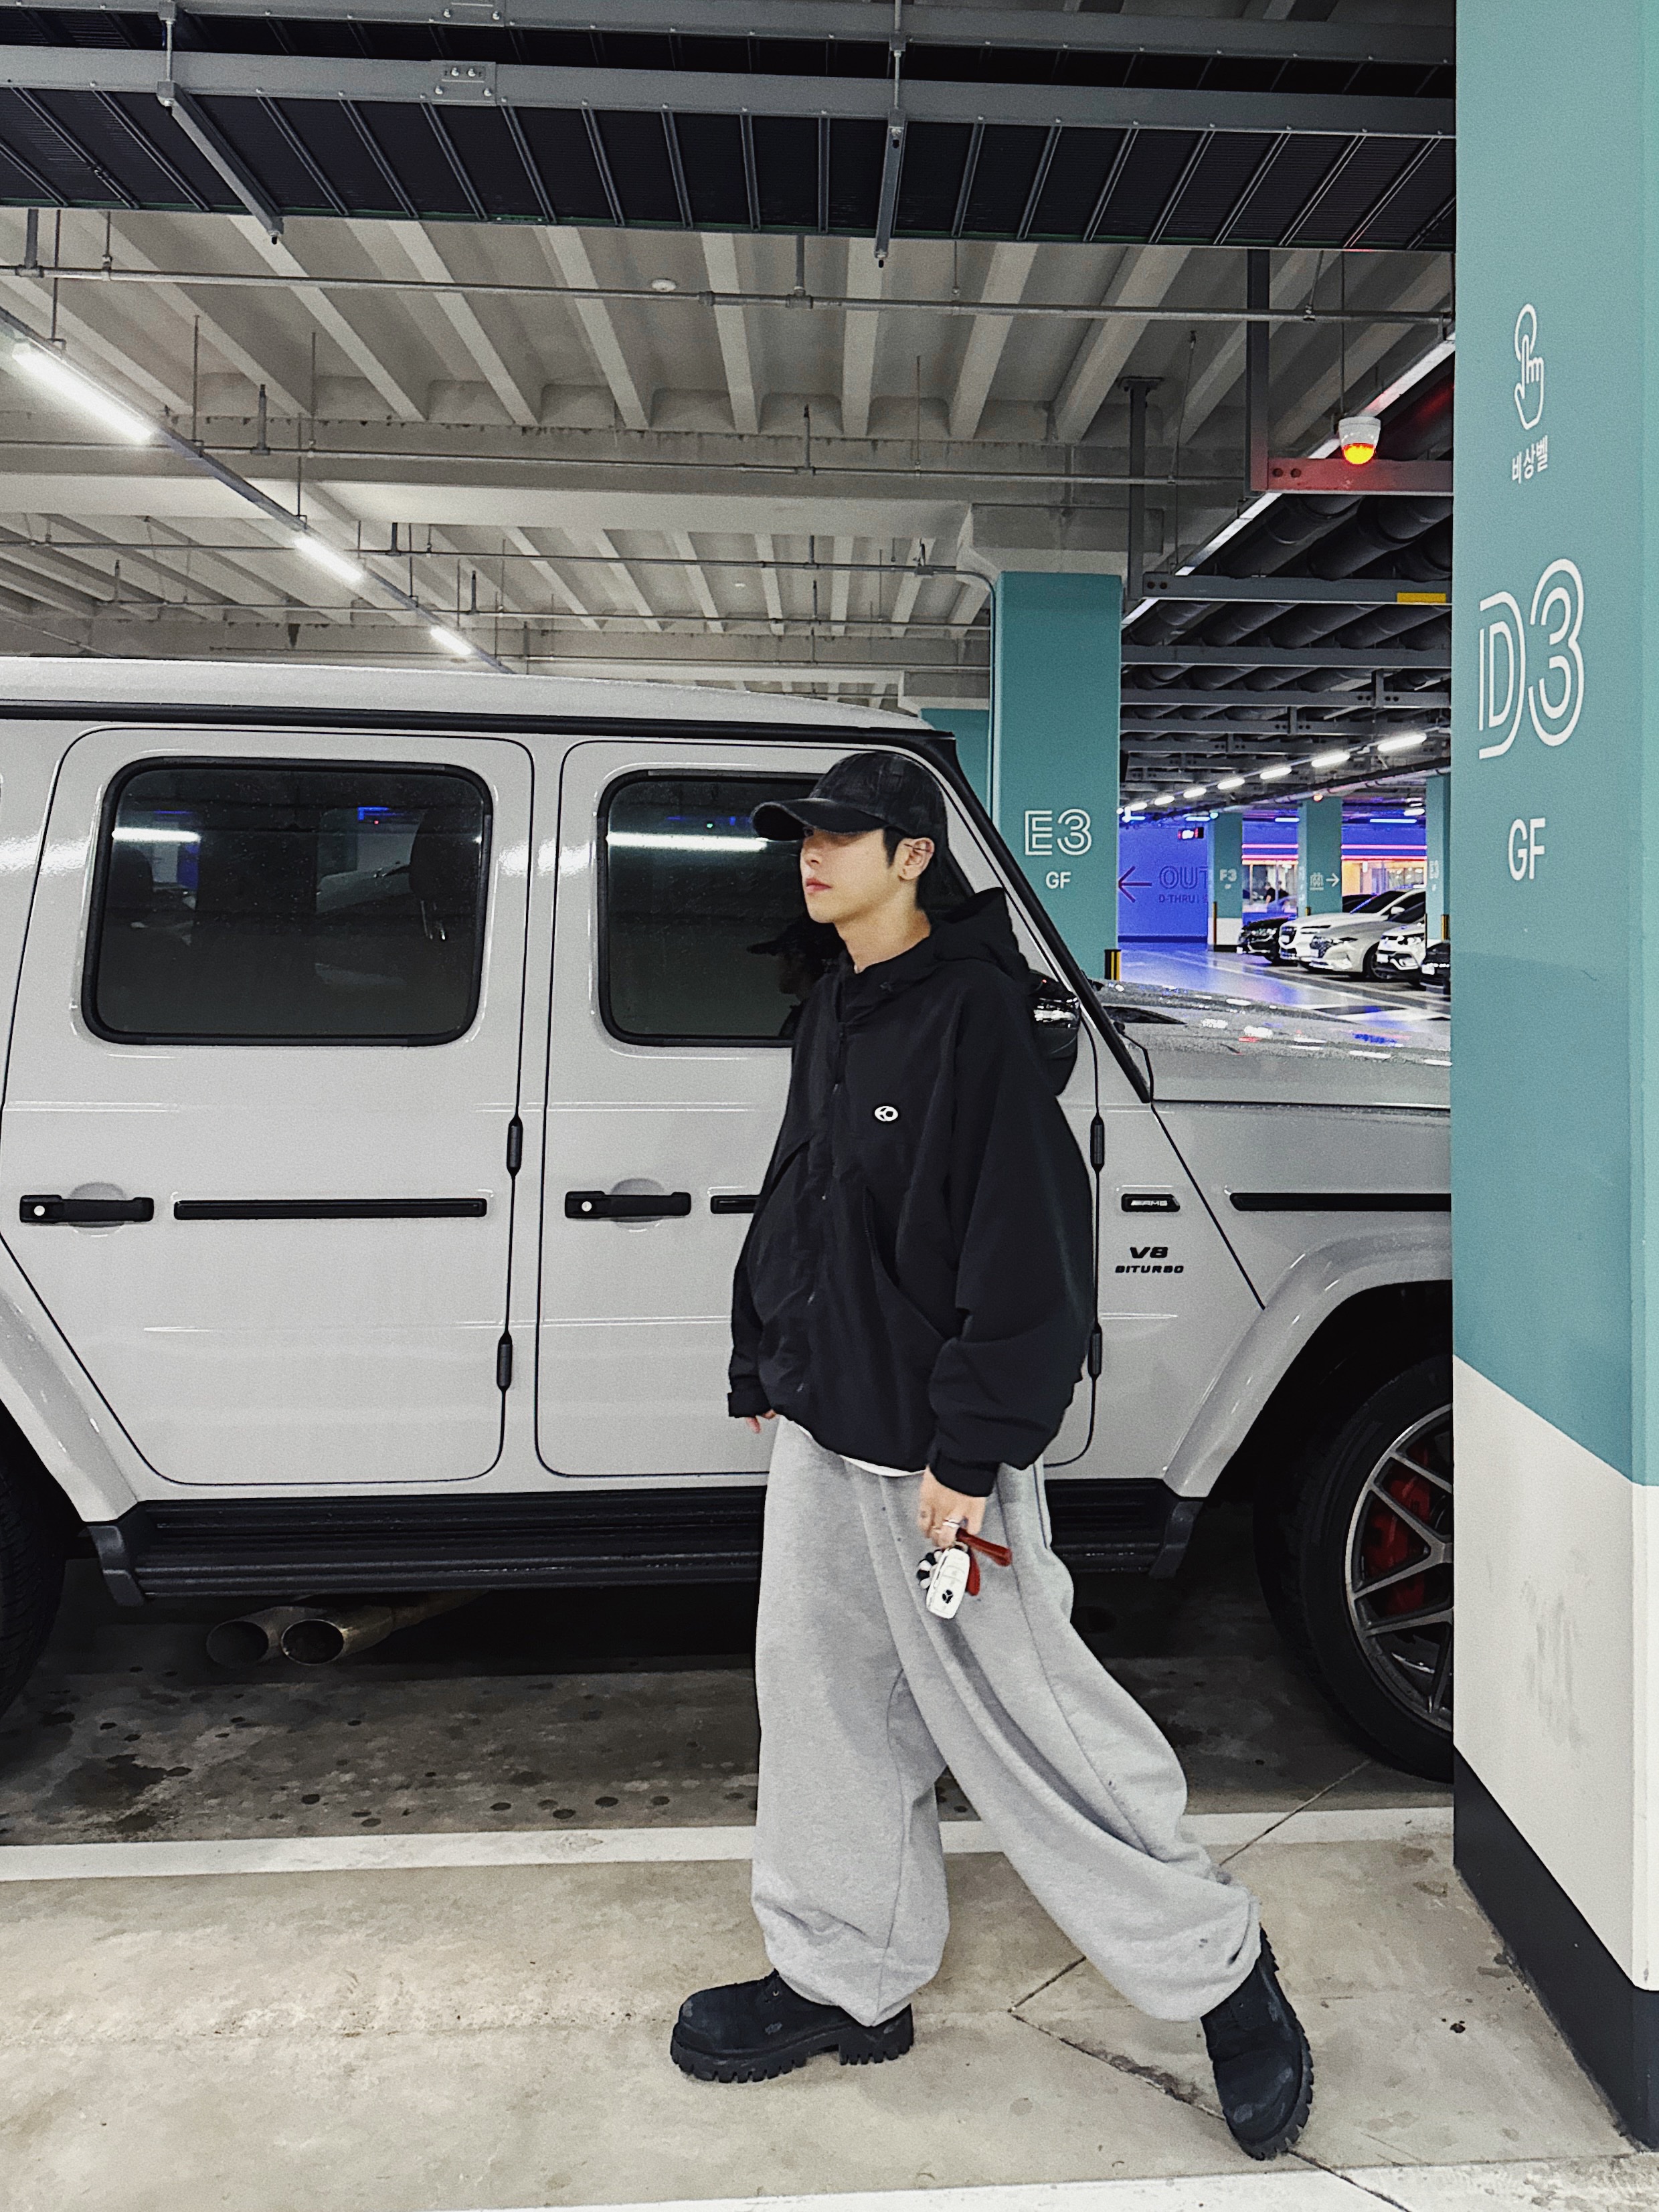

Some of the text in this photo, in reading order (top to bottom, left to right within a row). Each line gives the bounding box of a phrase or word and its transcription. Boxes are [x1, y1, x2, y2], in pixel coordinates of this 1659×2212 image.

[1512, 435, 1548, 484] 비상벨
[1479, 558, 1584, 759] D3
[1025, 808, 1092, 856] E3
[1508, 817, 1546, 881] GF
[1045, 871, 1071, 889] GF
[1159, 865, 1209, 890] OUT
[1219, 868, 1237, 882] F3
[1130, 1247, 1168, 1259] V8
[1115, 1265, 1184, 1273] BITURBO
